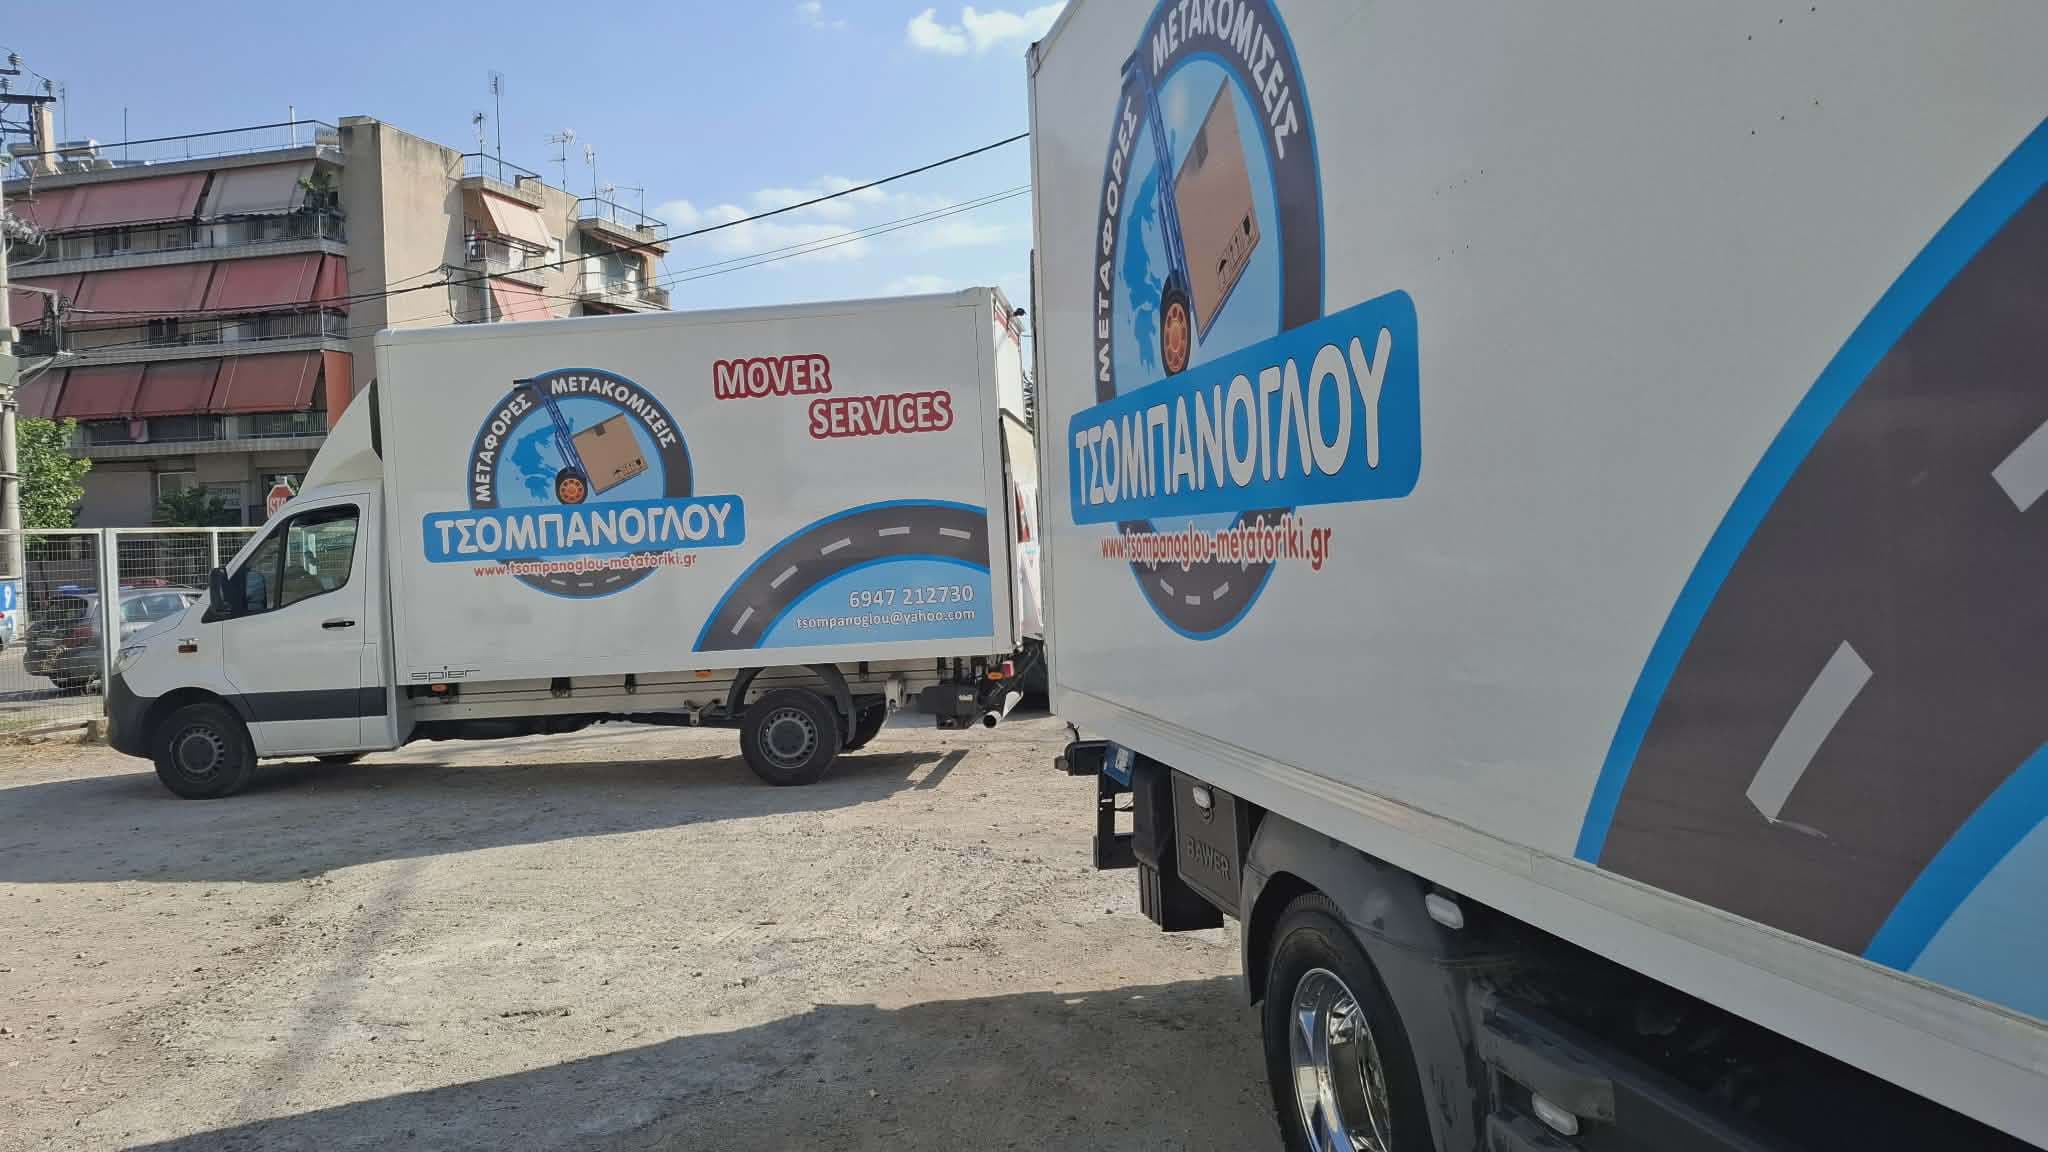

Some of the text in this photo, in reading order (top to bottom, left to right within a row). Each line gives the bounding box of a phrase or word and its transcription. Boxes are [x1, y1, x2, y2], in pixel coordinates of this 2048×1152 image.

[1152, 0, 1299, 160] ΜΕΤΑΚΟΜΙΣΕΙΣ
[1098, 96, 1137, 382] ΜΕΤΑΦΟΡΕΣ
[715, 356, 830, 398] MOVER
[551, 376, 677, 449] ΜΕΤΑΚΟΜΙΣΕΙΣ
[811, 393, 951, 437] SERVICES
[1076, 327, 1392, 505] ΤΣΟΜΠΑΝΟΓΛΟΥ
[475, 393, 533, 502] ΜΕΤΑΦΟΡΕΣ
[434, 502, 732, 554] ΤΣΟΜΠΑΝΟΓΛΟΥ
[1101, 514, 1332, 571] www.tsompanoglou-metaforiki.gr
[473, 549, 698, 577] www.tsompanoglou-metaforiki.gr
[797, 610, 976, 630] tsompanoglou@yahoo.com
[849, 585, 974, 608] 6947 212730
[411, 665, 480, 683] spier
[1186, 834, 1231, 881] BAWER
